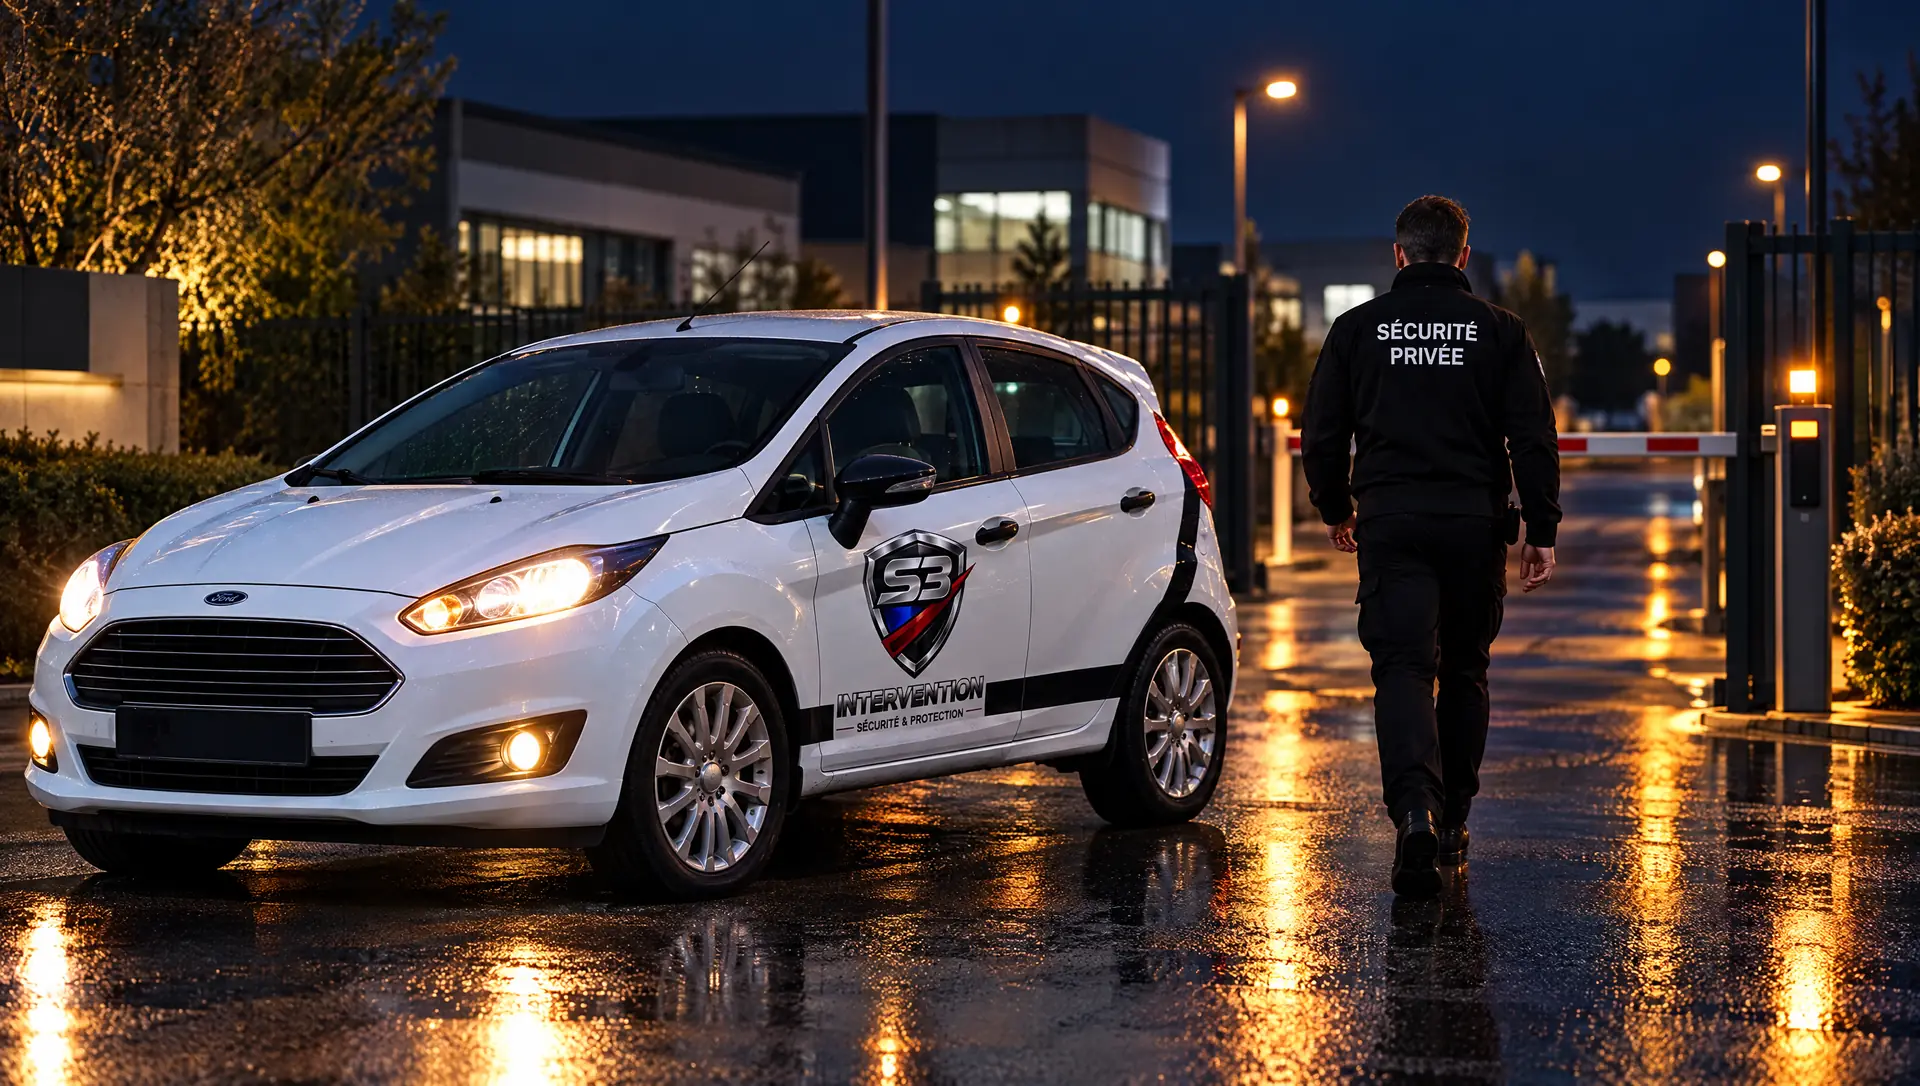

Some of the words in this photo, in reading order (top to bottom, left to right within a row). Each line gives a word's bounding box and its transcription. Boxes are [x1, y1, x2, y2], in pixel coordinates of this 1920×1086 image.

[1377, 319, 1478, 342] SÉCURITÉ
[1390, 343, 1464, 366] PRIVÉE
[876, 555, 953, 606] S3
[836, 675, 985, 718] INTERVENTION
[856, 716, 899, 733] SÉCURITÉ
[902, 716, 908, 726] &
[910, 708, 964, 725] PROTECTION
